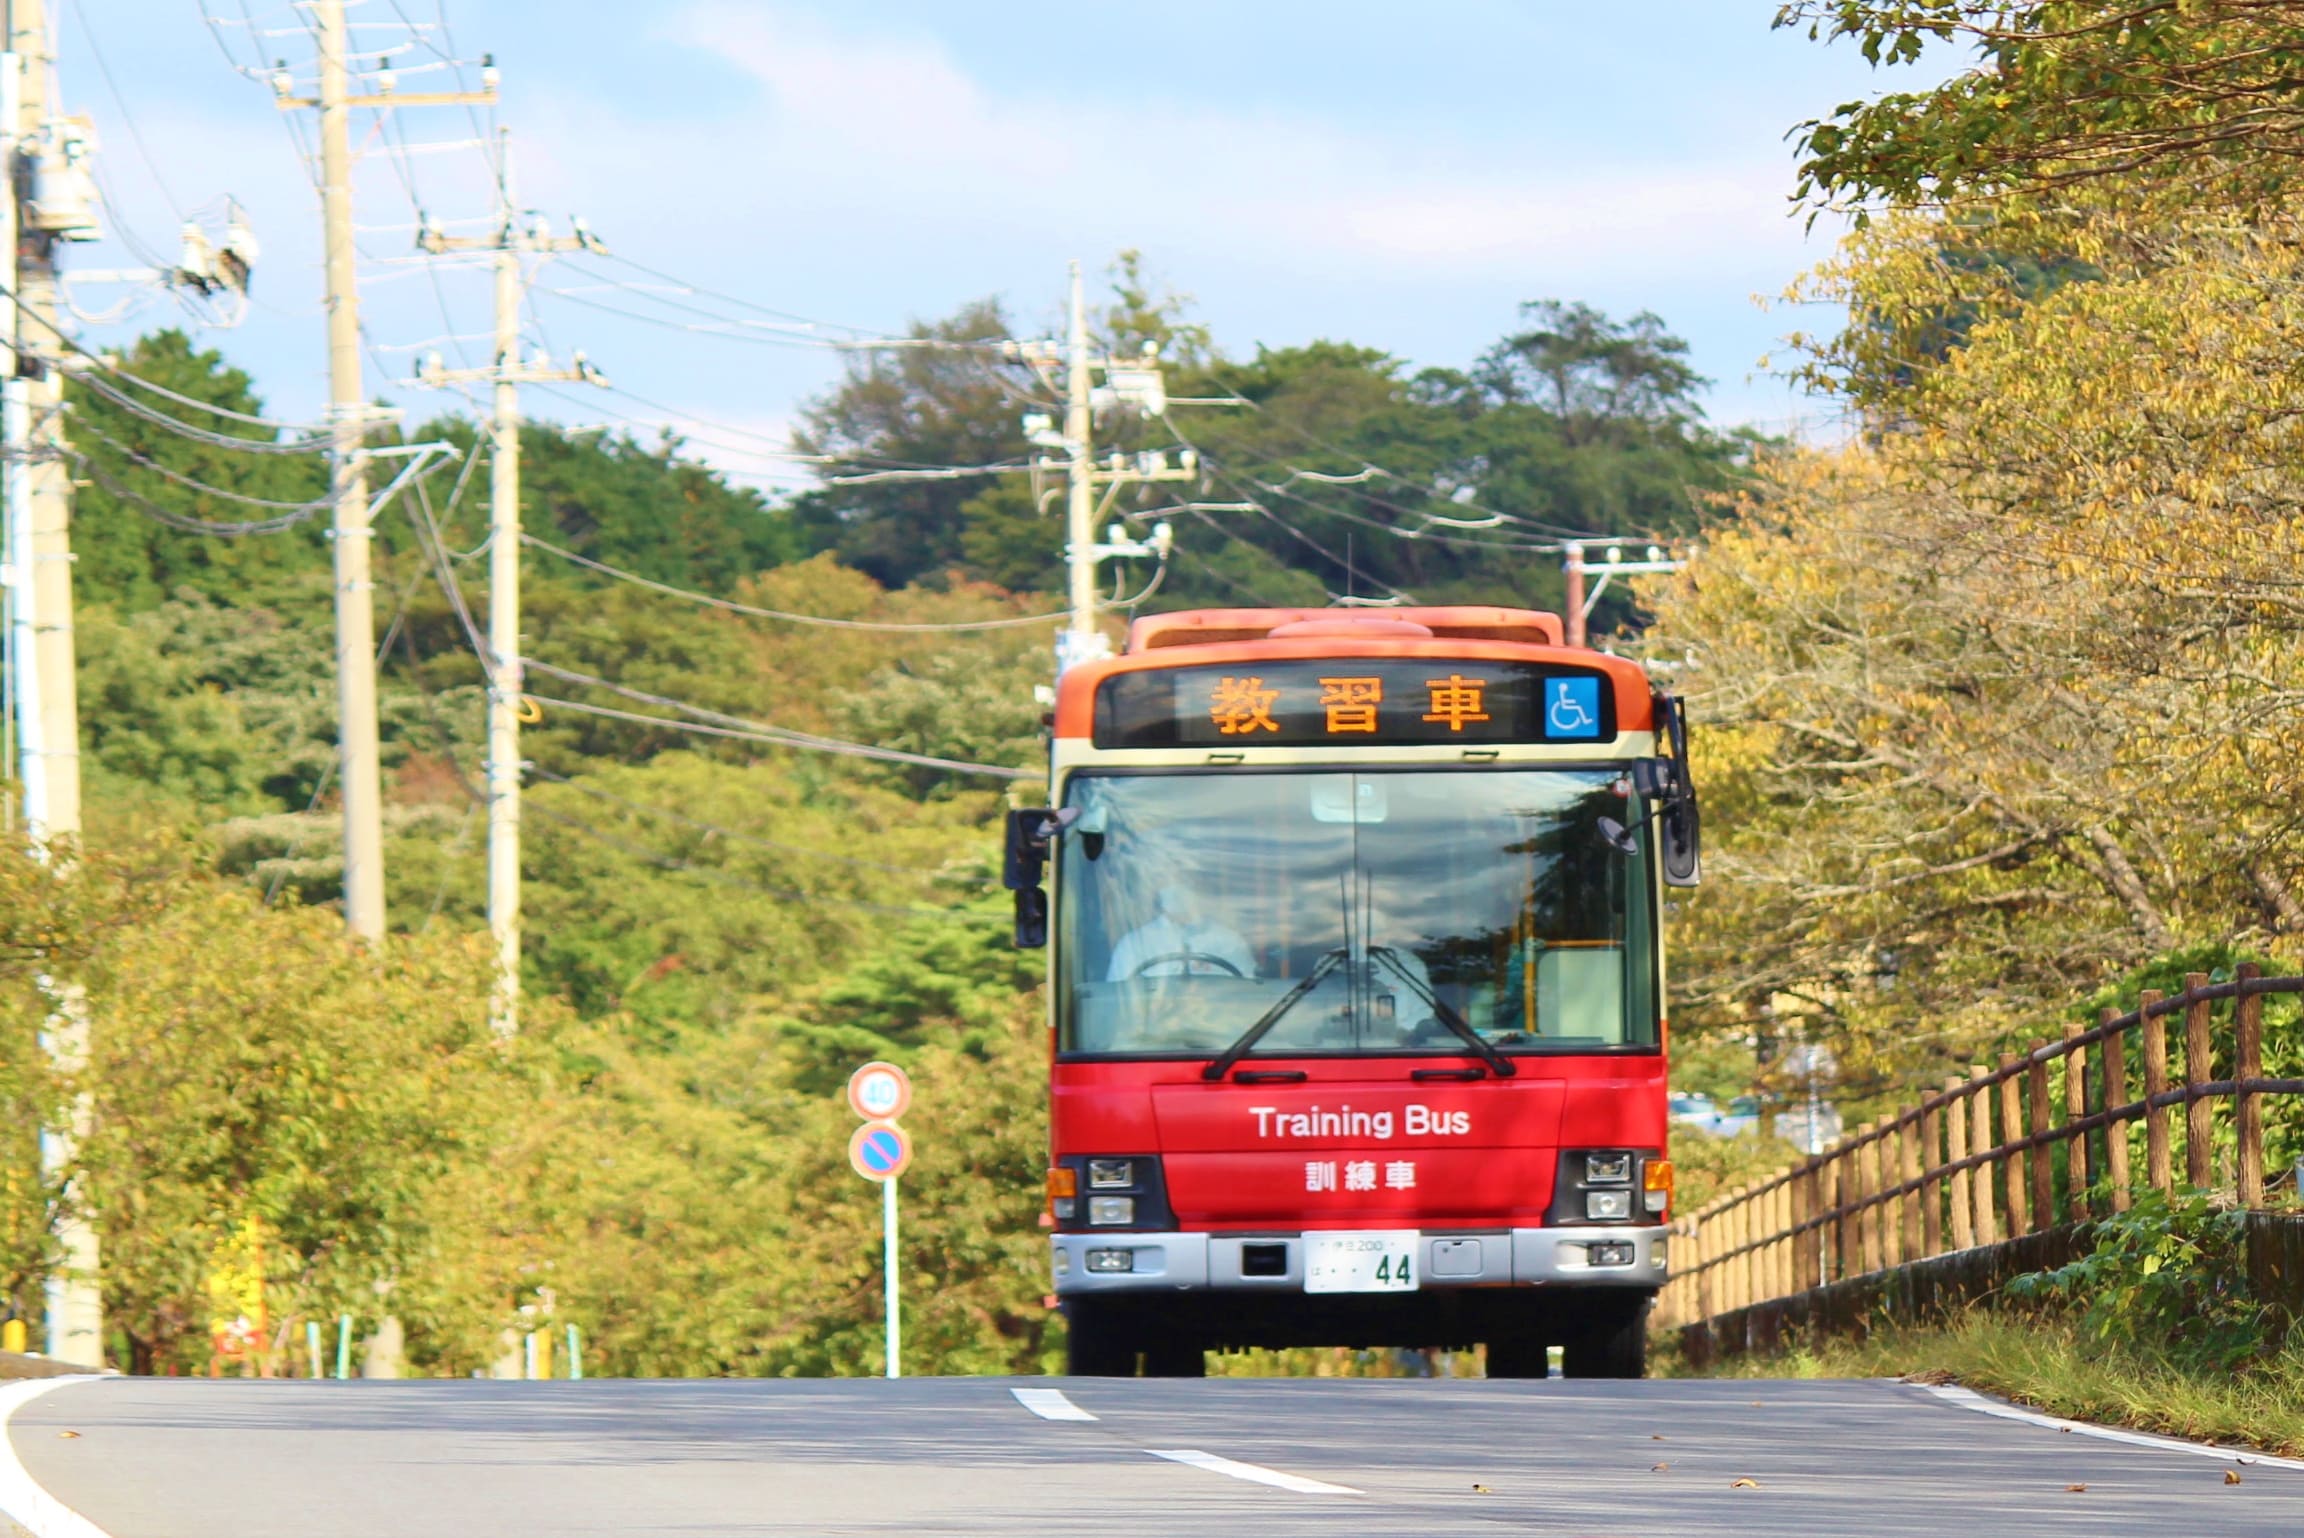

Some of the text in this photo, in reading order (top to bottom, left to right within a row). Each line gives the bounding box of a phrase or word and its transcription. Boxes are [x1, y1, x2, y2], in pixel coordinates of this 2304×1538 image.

[1209, 675, 1490, 734] 教習車
[863, 1080, 896, 1104] 40
[1248, 1104, 1471, 1139] Training Bus
[1304, 1160, 1417, 1192] 訓練車
[1357, 1240, 1384, 1252] 200
[1375, 1254, 1411, 1285] 44
